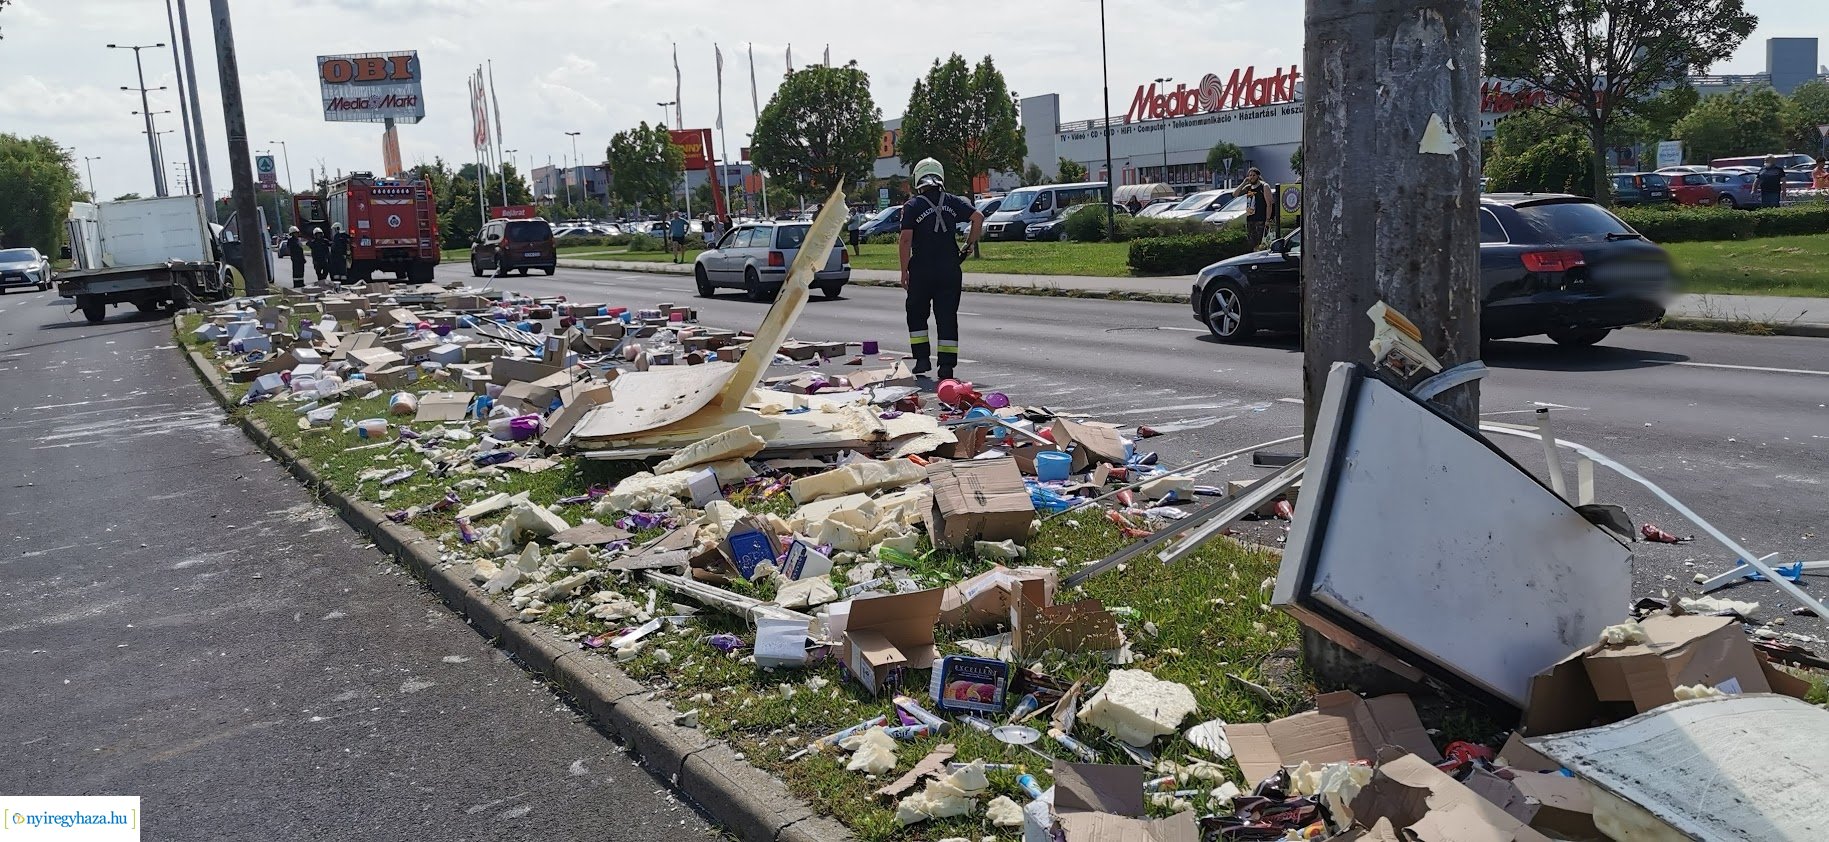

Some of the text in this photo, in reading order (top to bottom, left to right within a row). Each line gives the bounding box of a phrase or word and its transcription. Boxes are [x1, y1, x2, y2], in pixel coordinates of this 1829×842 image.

[322, 56, 413, 83] OBI
[327, 94, 417, 111] Media Markt
[1123, 65, 1301, 125] Media Markt
[1060, 134, 1067, 142] TV
[1090, 130, 1099, 138] CD
[1103, 128, 1115, 137] DD
[1137, 123, 1166, 133] Computer
[1172, 114, 1232, 129] Telekommunikáció
[1239, 107, 1277, 121] Háztartási
[1281, 103, 1304, 116] készü
[683, 143, 702, 153] NNY
